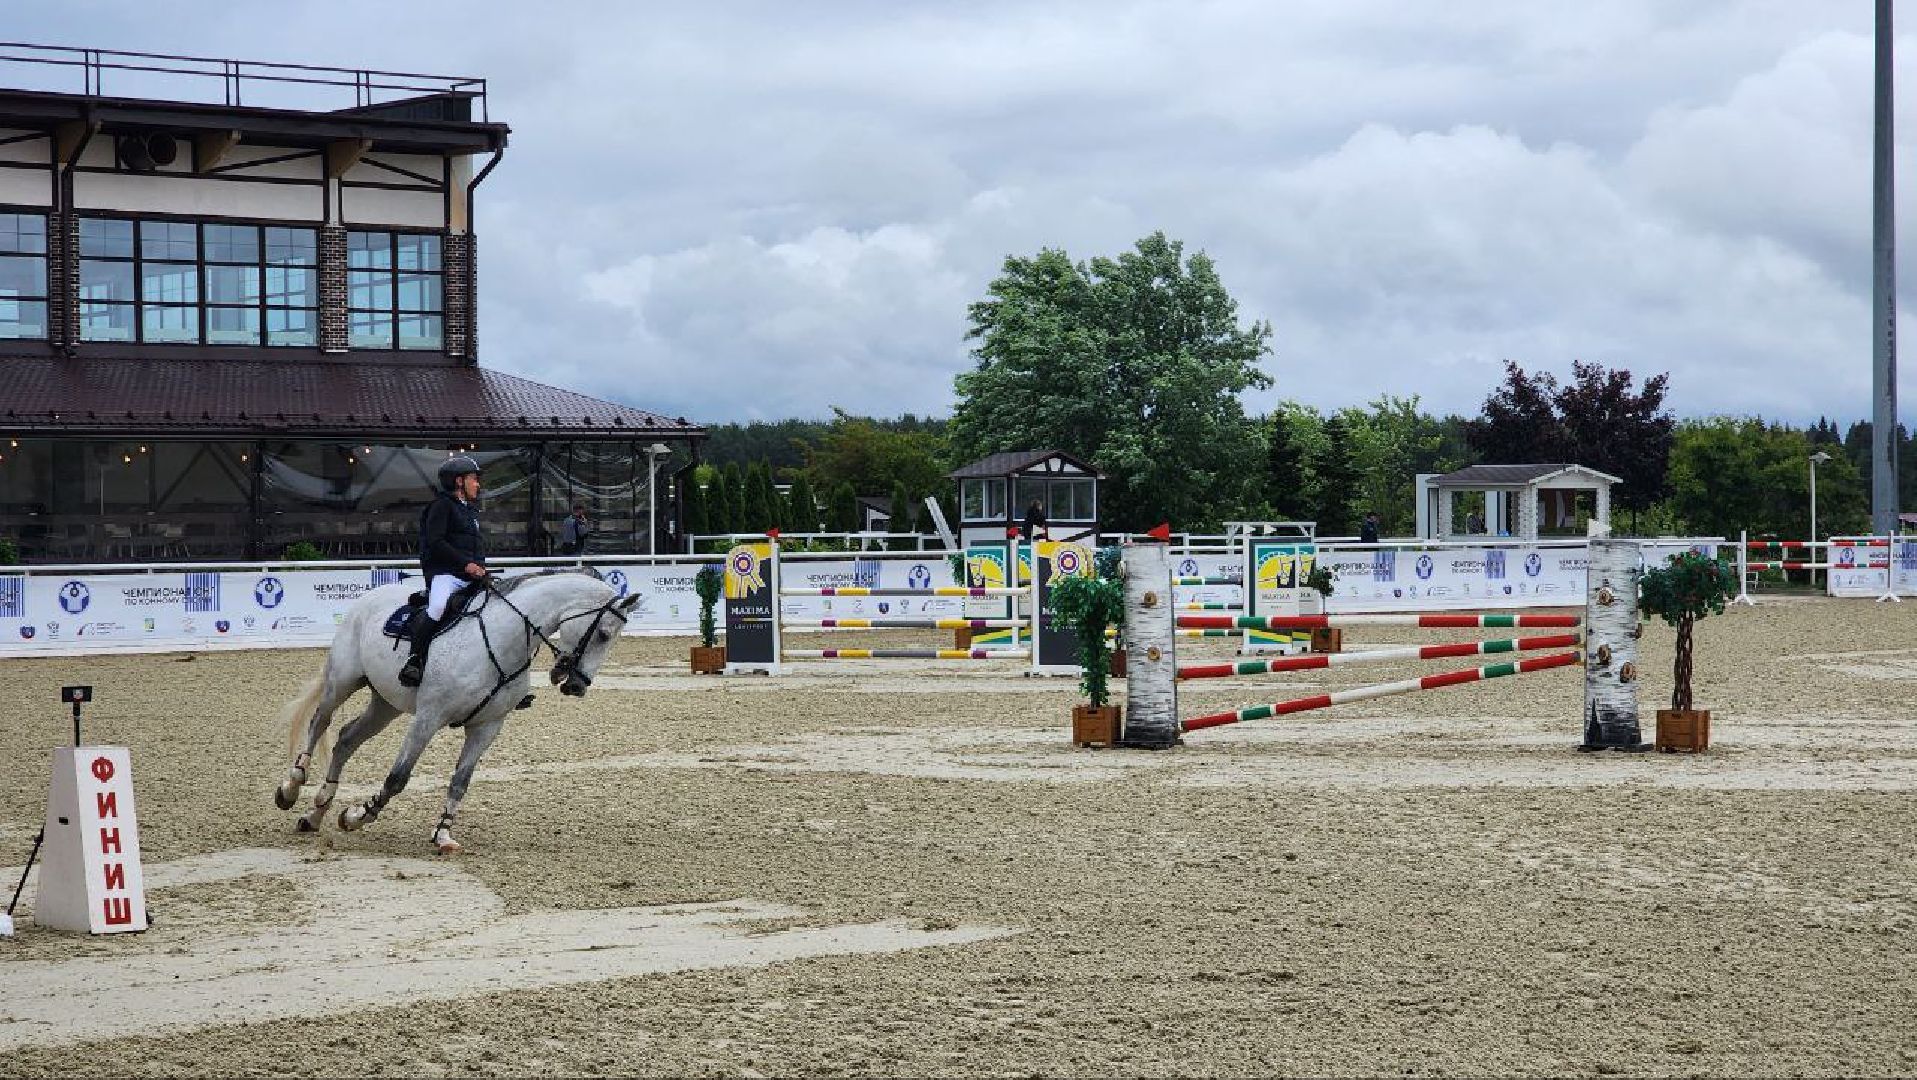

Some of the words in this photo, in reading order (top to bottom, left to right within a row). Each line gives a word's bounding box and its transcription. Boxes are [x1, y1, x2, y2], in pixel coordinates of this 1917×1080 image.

[653, 577, 697, 586] ЧЕМПИОН
[731, 606, 770, 615] MAXIMA
[91, 756, 131, 925] ФИНИШ
